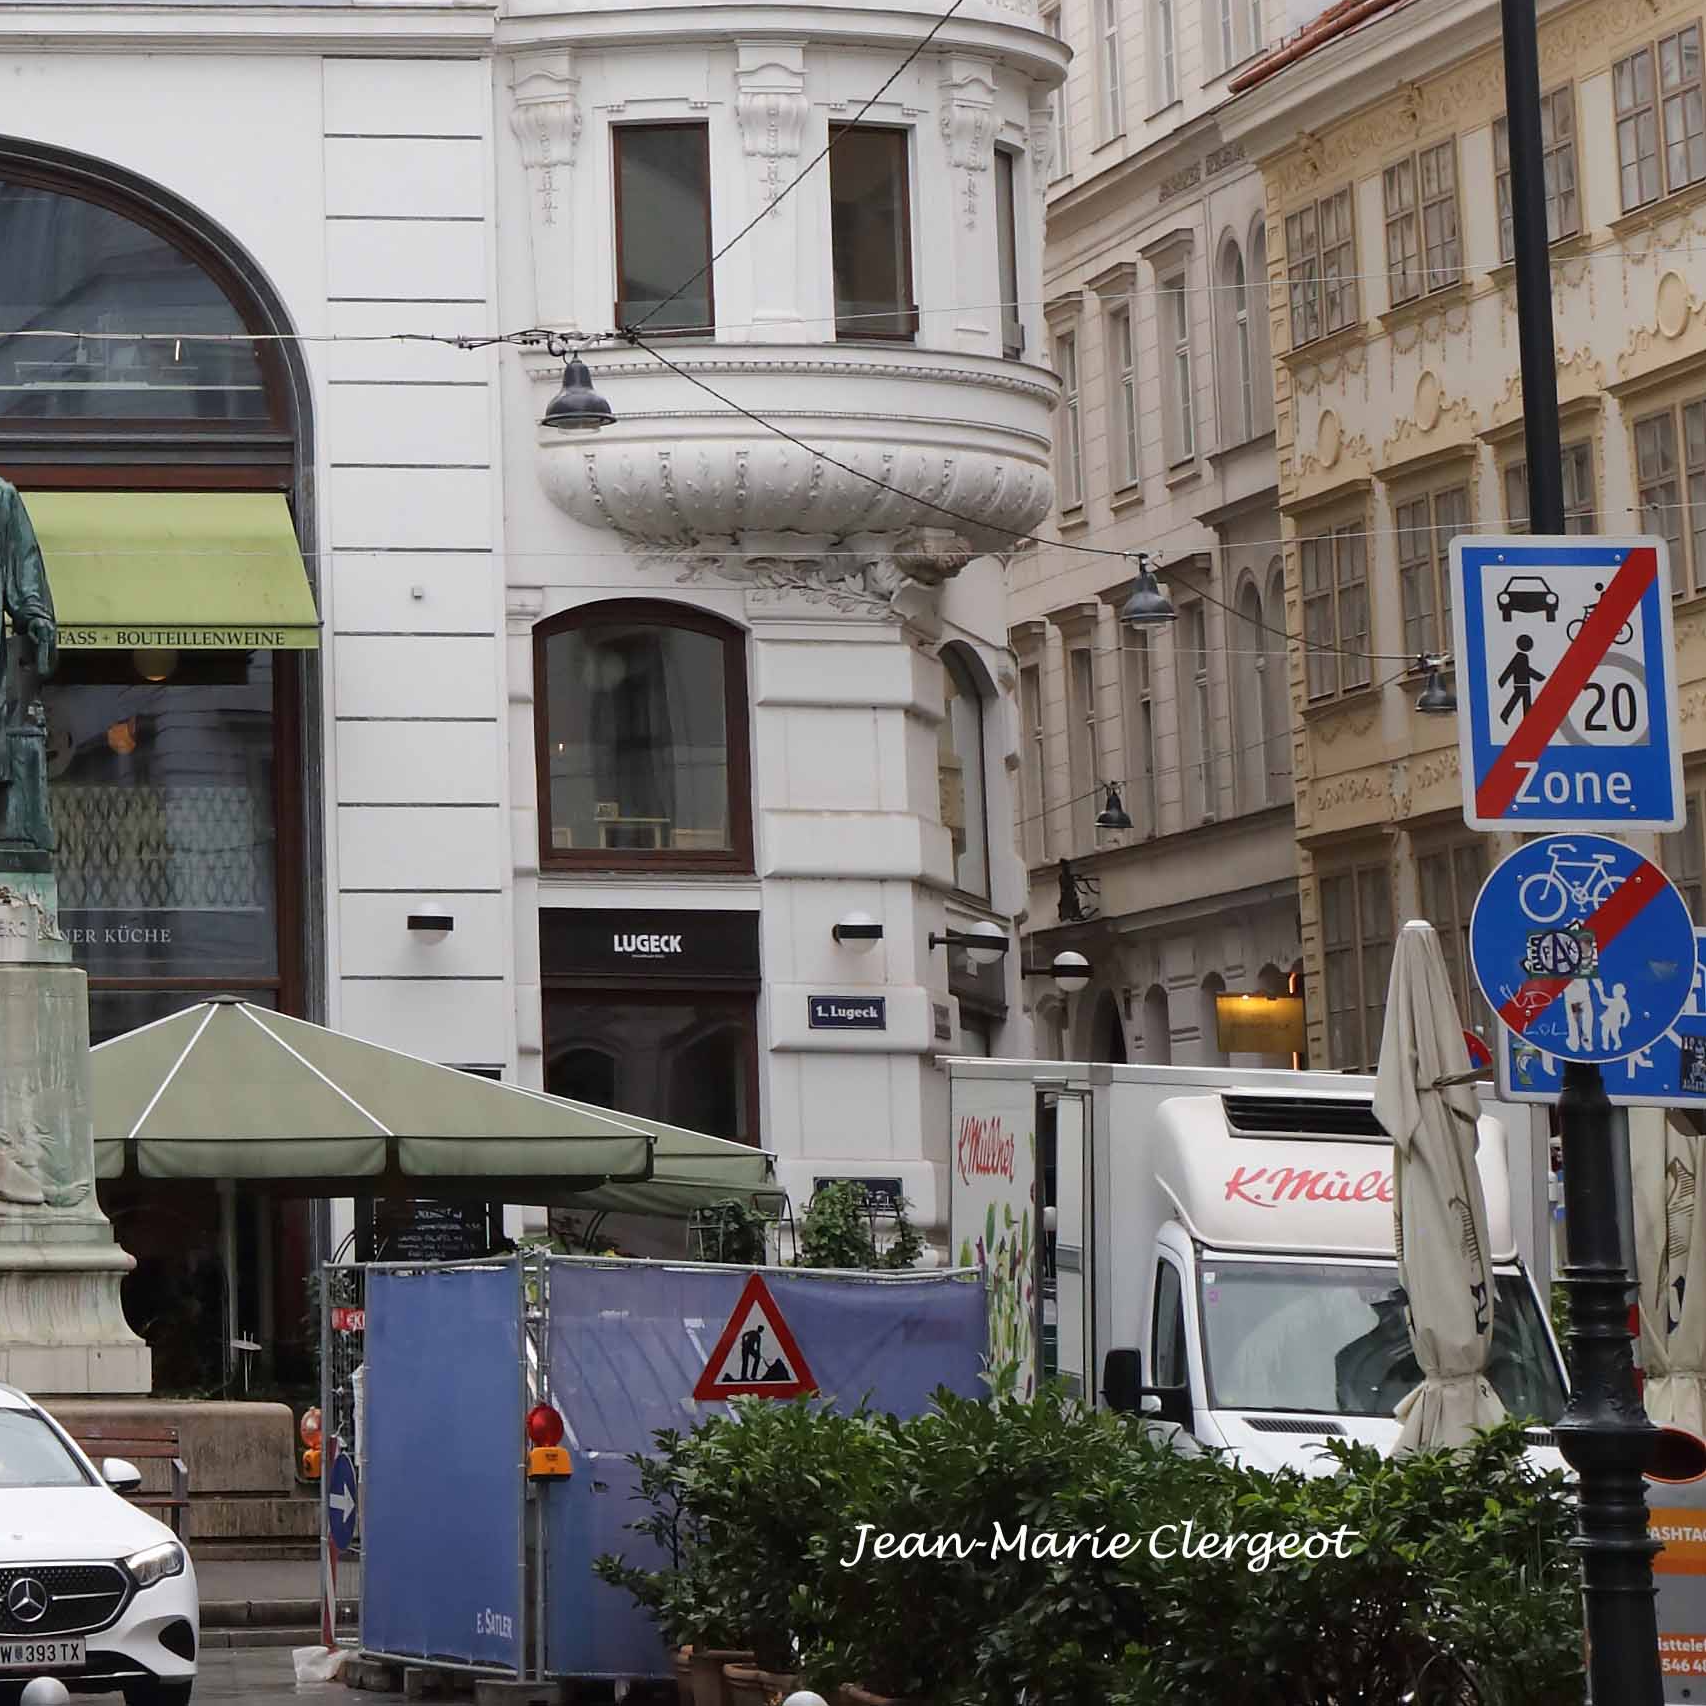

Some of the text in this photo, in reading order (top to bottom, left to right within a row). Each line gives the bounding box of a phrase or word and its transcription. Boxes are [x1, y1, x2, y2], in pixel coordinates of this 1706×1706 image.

[57, 630, 98, 646] FASS
[117, 630, 286, 646] BOUTEILLENWEINE
[1583, 682, 1637, 732] 20
[1514, 761, 1632, 805] Zone
[105, 924, 172, 943] KÜCHE
[613, 934, 683, 953] LUGECK
[830, 1004, 879, 1020] Lugeck
[25, 1644, 56, 1663] 393
[60, 1643, 79, 1661] TX
